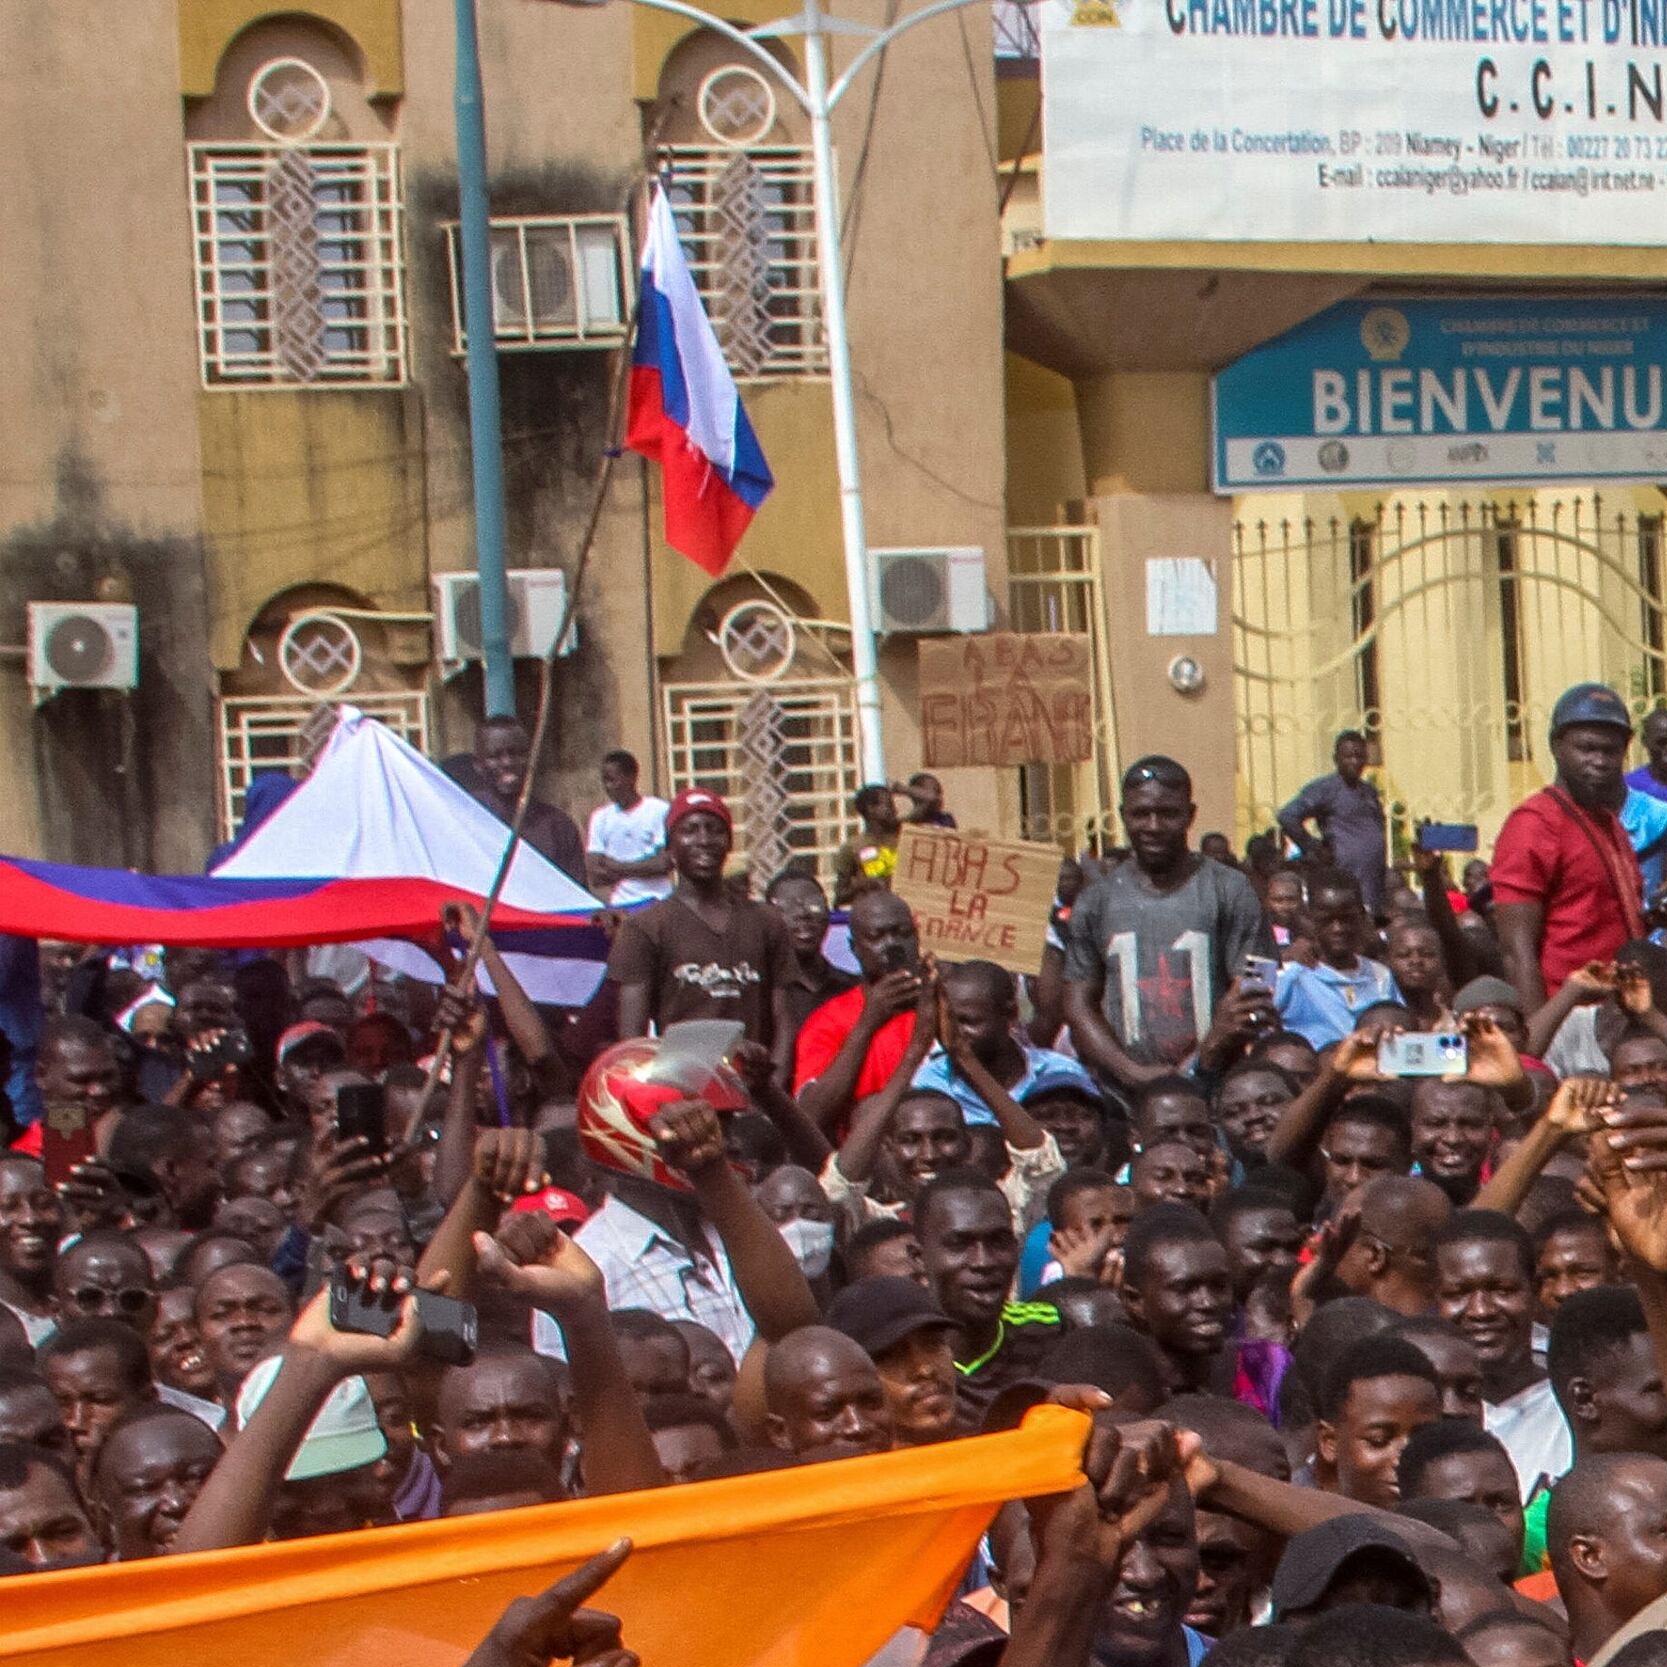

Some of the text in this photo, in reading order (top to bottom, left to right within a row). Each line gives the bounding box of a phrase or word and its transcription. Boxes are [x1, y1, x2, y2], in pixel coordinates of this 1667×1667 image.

[1166, 0, 1319, 38] CHAMBRE
[1328, 0, 1366, 39] DE
[1377, 0, 1548, 43] COMMERCE
[1558, 0, 1592, 42] ET
[1140, 125, 1183, 152] Place
[1189, 128, 1209, 151] de
[1214, 129, 1228, 151] la
[1339, 131, 1361, 153] BP
[1405, 130, 1461, 160] Niamey
[1478, 132, 1520, 163] Niger
[1614, 136, 1630, 158] 20
[1635, 136, 1651, 158] 73
[1318, 162, 1363, 188] E-mail
[949, 889, 989, 920] LA
[1107, 929, 1213, 1047] 11
